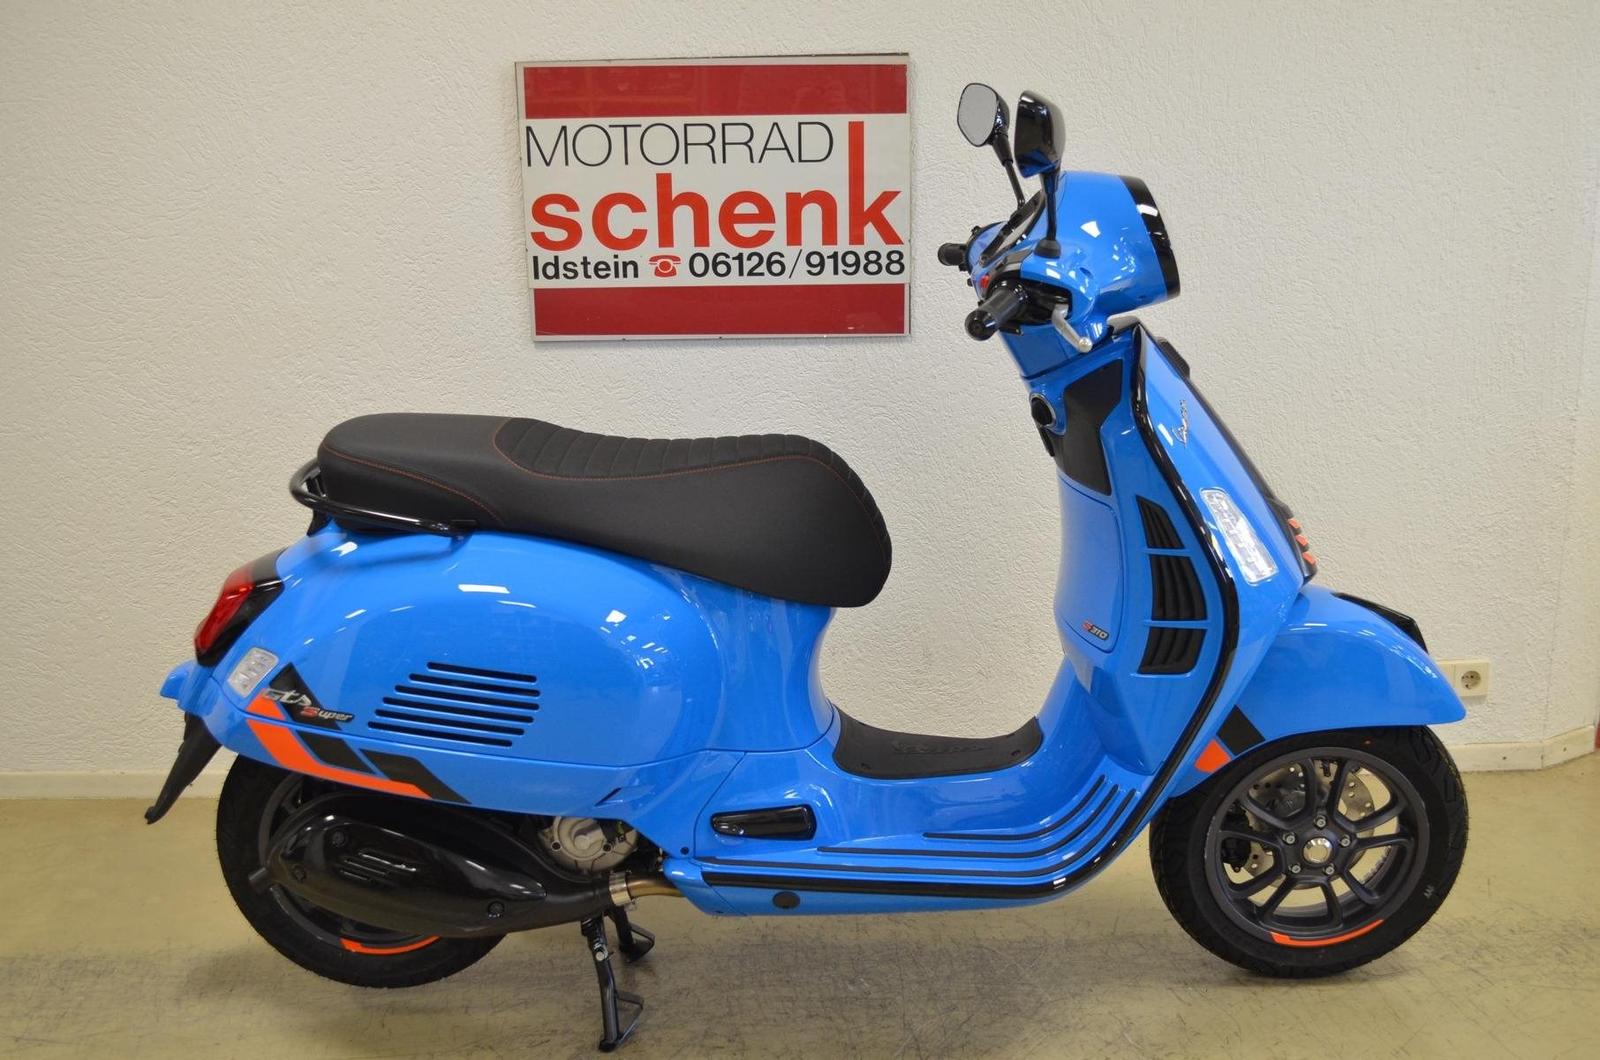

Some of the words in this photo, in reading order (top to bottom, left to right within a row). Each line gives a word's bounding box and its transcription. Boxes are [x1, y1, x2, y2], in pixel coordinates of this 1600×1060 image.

[524, 121, 834, 167] MOTORRAD
[529, 120, 905, 252] schenk
[532, 254, 639, 281] Idstein
[688, 249, 906, 280] 06126/91988
